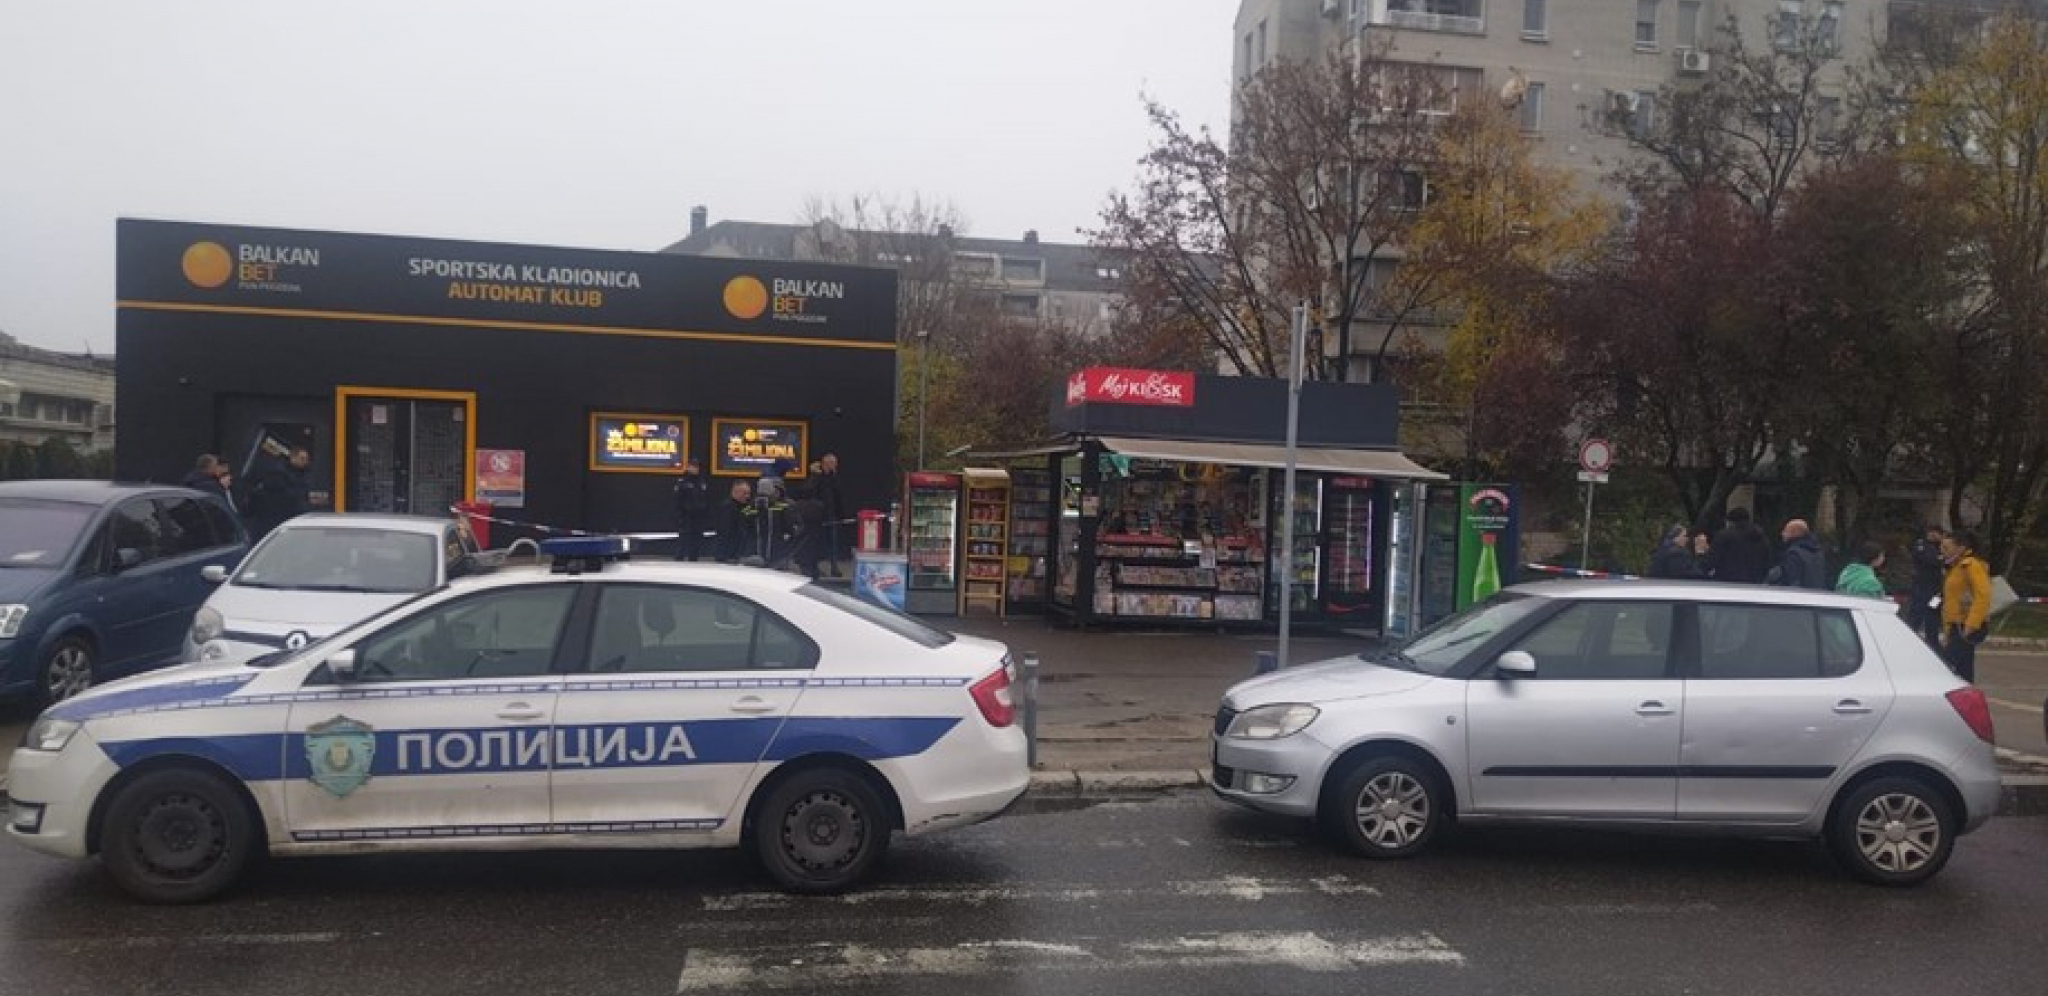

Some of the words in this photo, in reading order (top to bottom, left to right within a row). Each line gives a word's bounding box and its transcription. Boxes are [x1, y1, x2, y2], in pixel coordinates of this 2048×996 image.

[239, 244, 319, 266] BALKAN
[239, 262, 277, 281] BET
[408, 257, 517, 281] SPORTSKA
[522, 265, 642, 289] KLADIONICA
[448, 282, 545, 304] AUTOMAT
[550, 288, 603, 308] KLUB
[772, 278, 843, 299] BALKAN
[772, 296, 807, 312] BET
[1098, 373, 1129, 400] Moj
[1129, 376, 1182, 399] KIOSK
[396, 725, 698, 770] ПОЛИЦИЈА
